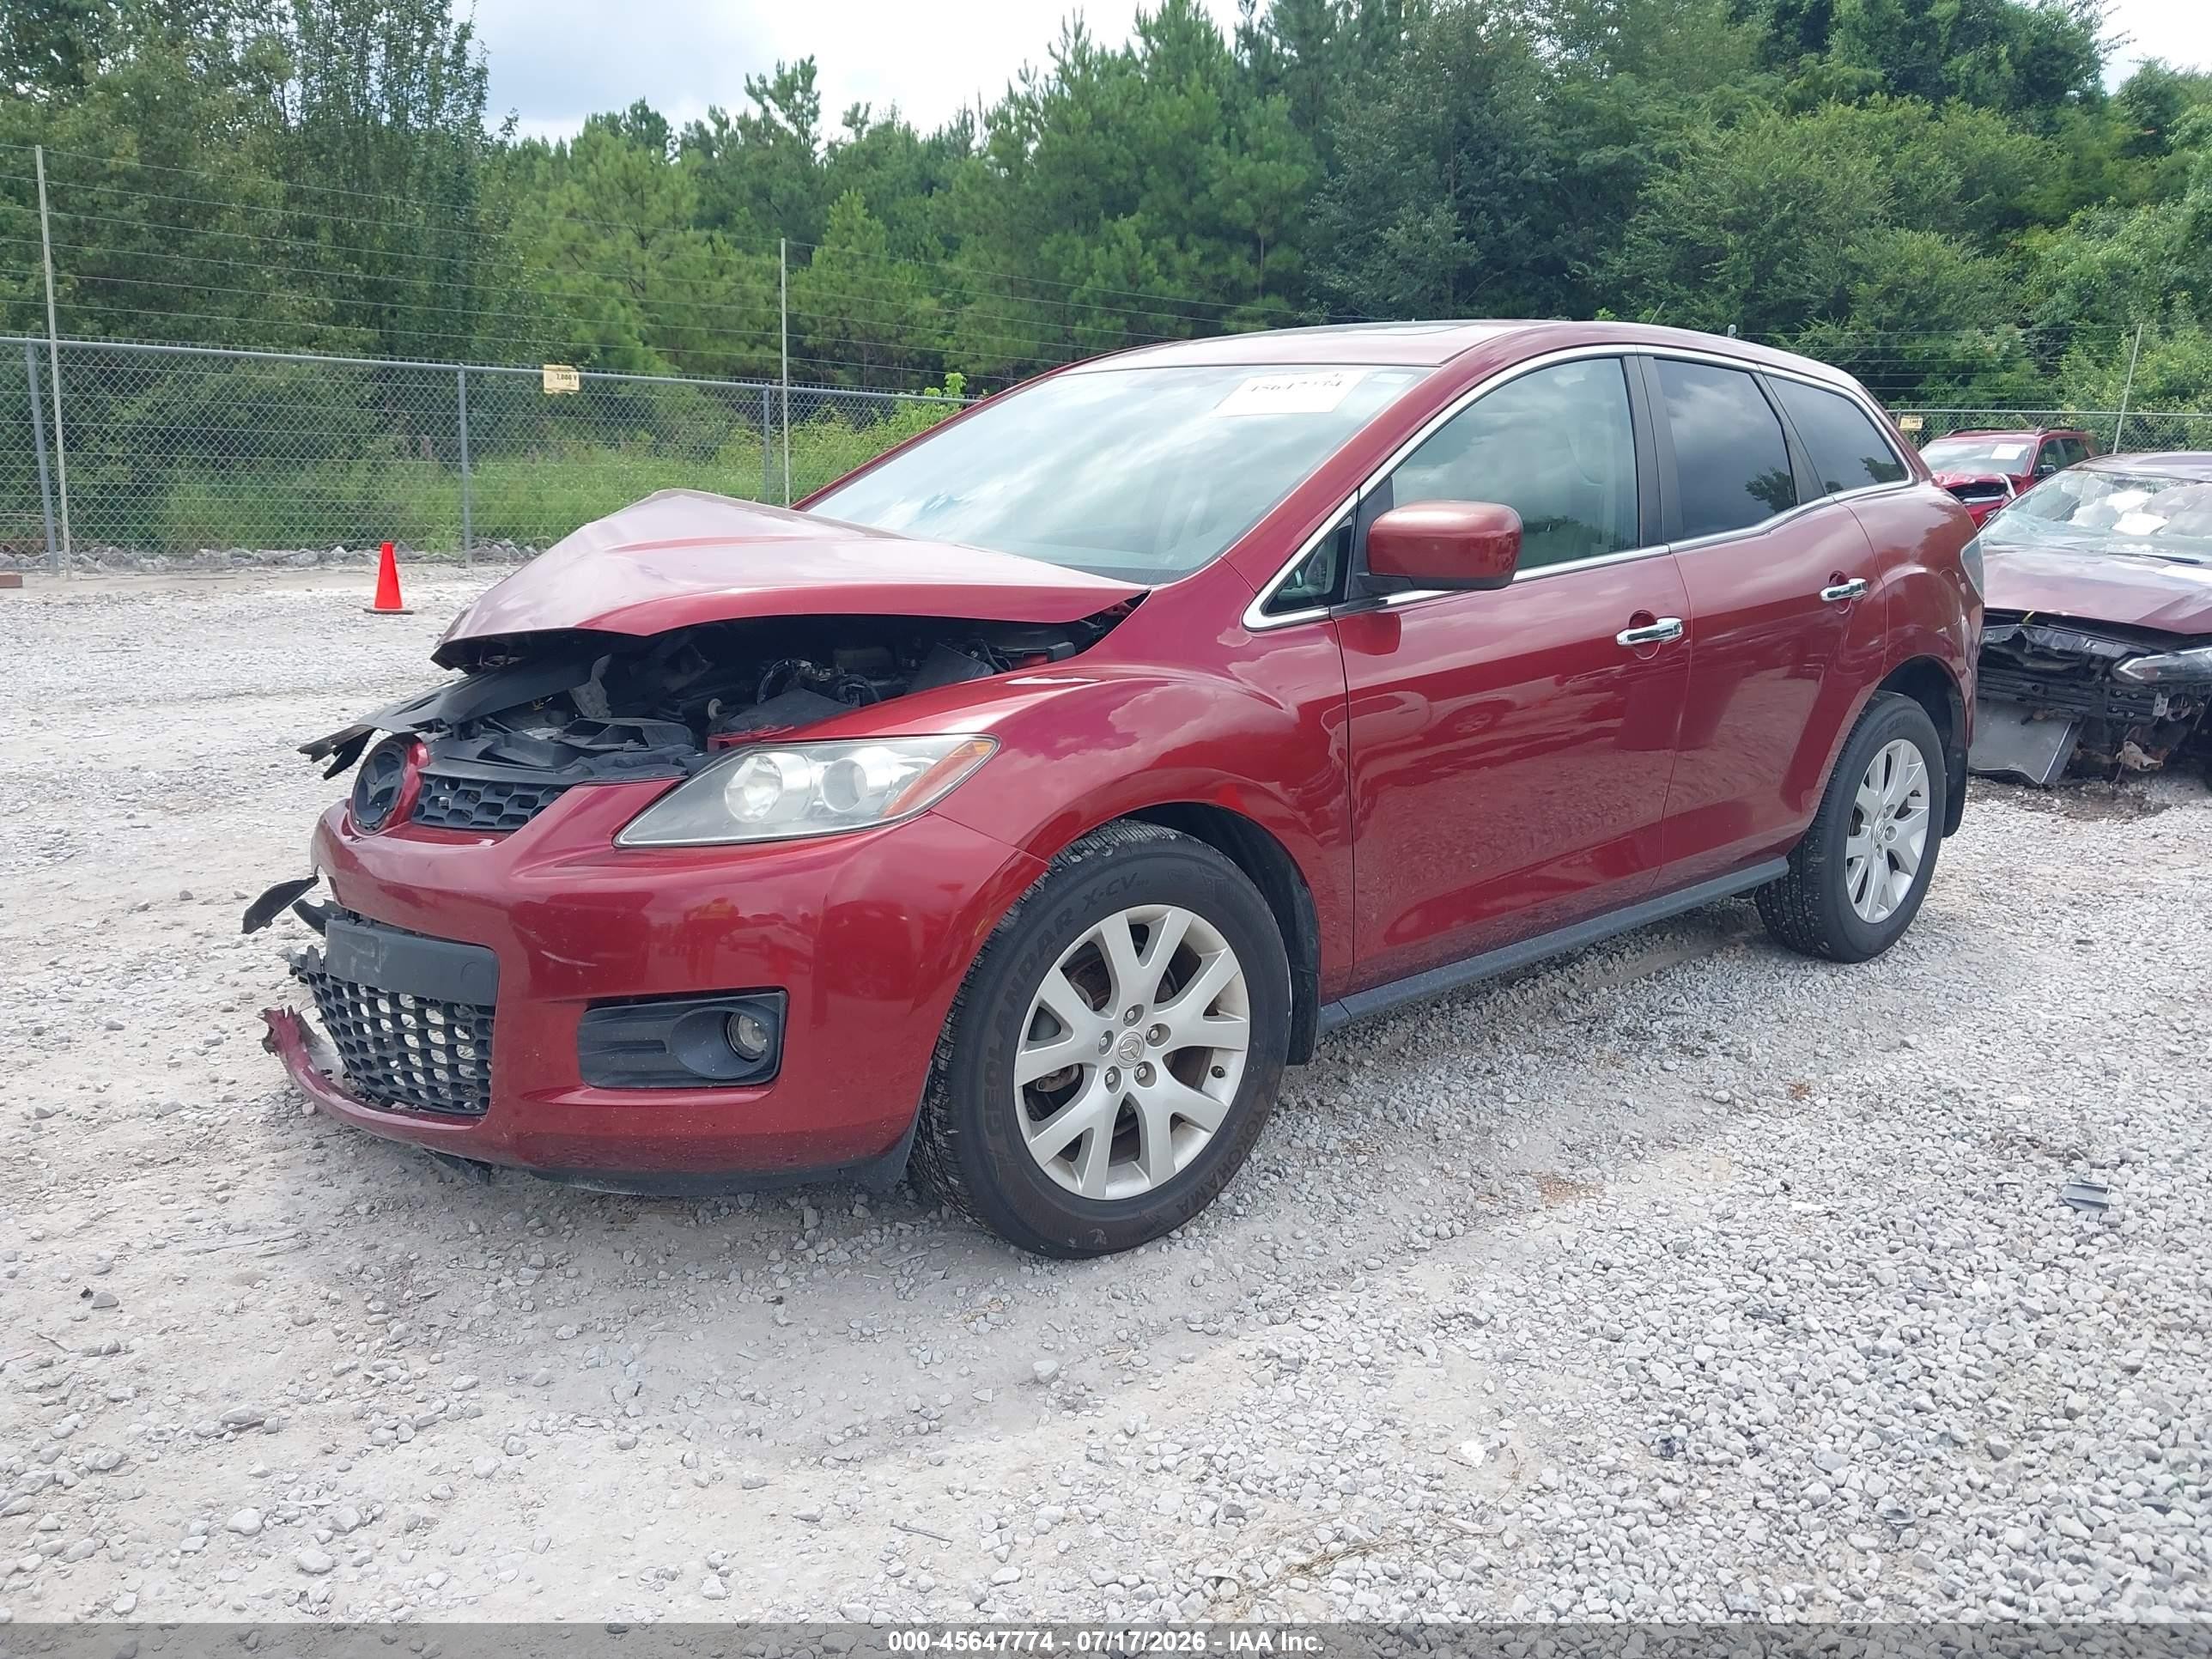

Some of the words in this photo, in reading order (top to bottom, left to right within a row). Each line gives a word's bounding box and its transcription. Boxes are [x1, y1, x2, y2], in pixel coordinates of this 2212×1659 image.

[981, 906, 1073, 1138] GEOLANDAR
[1082, 872, 1139, 913] X-CV
[1176, 1103, 1266, 1216] YOKOHAMA
